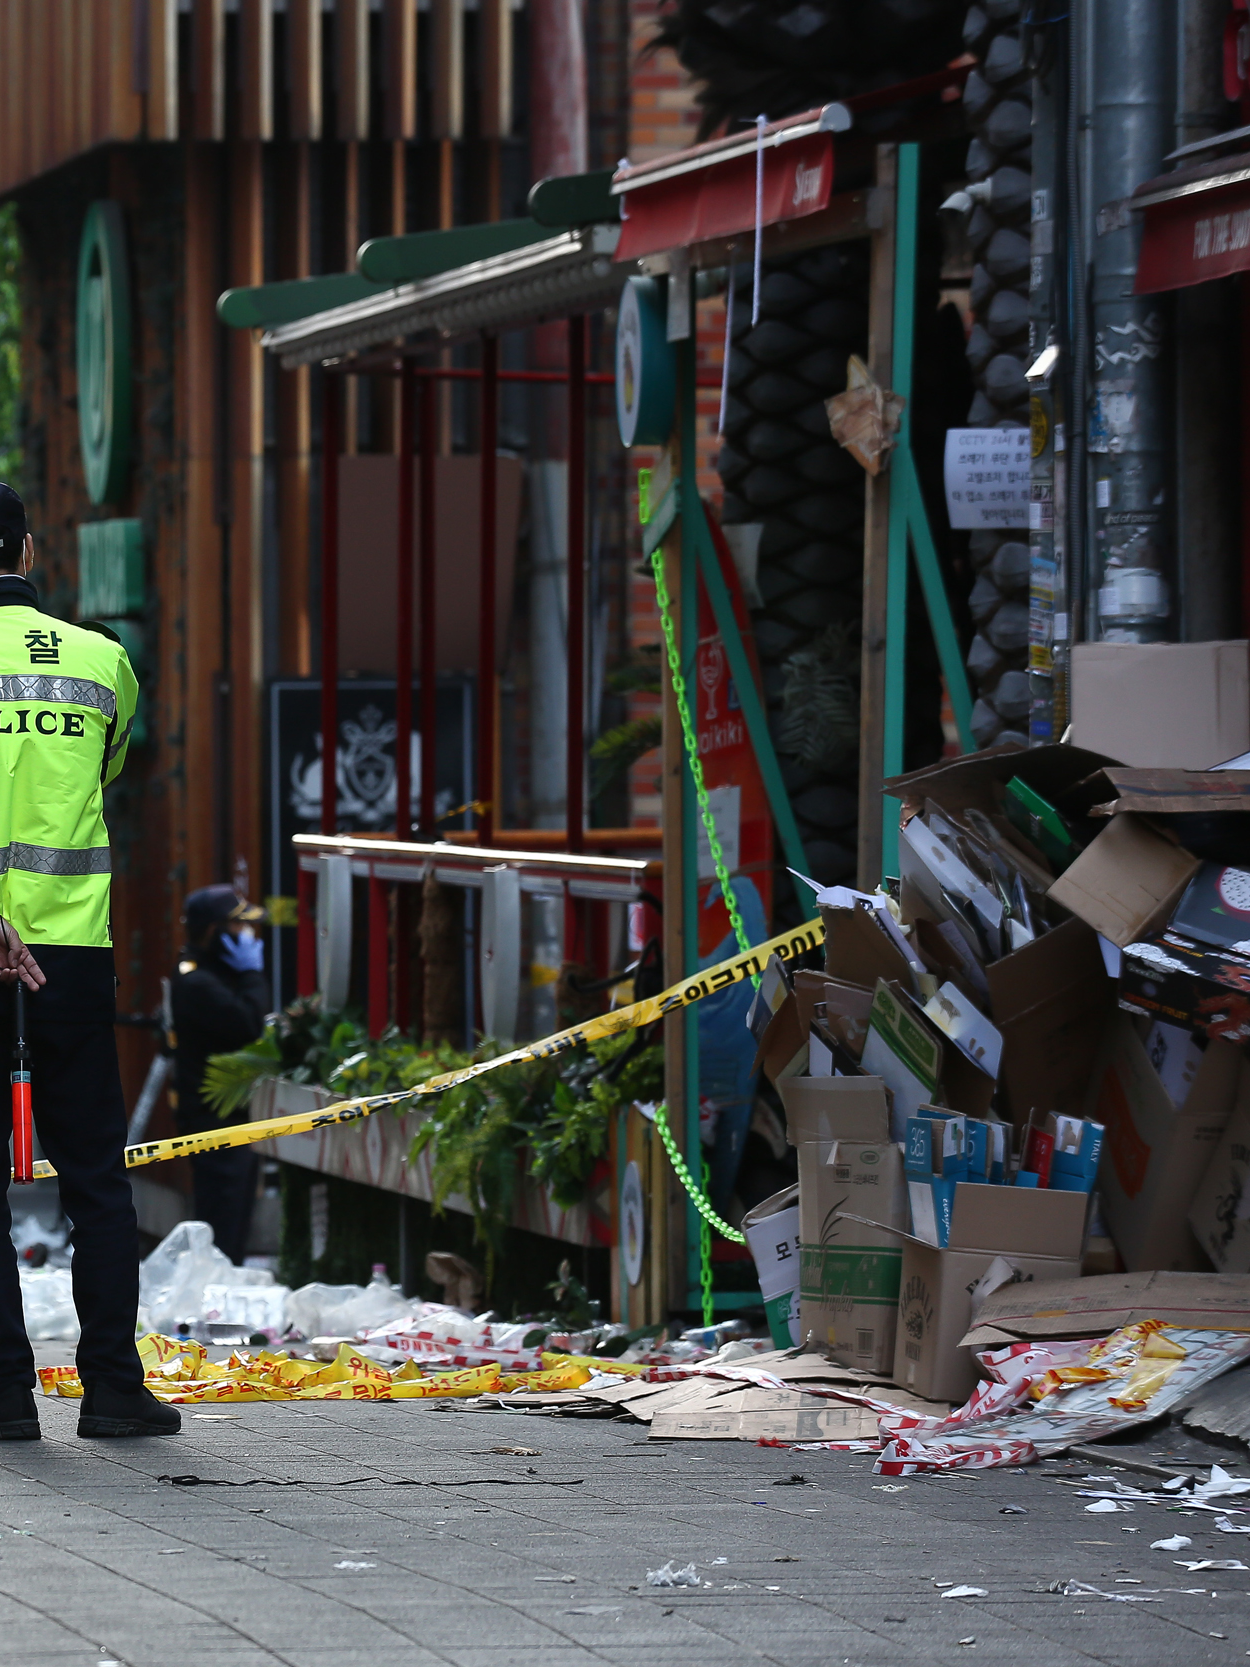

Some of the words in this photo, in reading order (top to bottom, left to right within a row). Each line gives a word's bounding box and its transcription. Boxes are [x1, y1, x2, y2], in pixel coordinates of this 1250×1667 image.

[698, 718, 744, 755] aikiki
[1090, 1139, 1101, 1163] ITALY
[776, 1236, 800, 1262] 모
